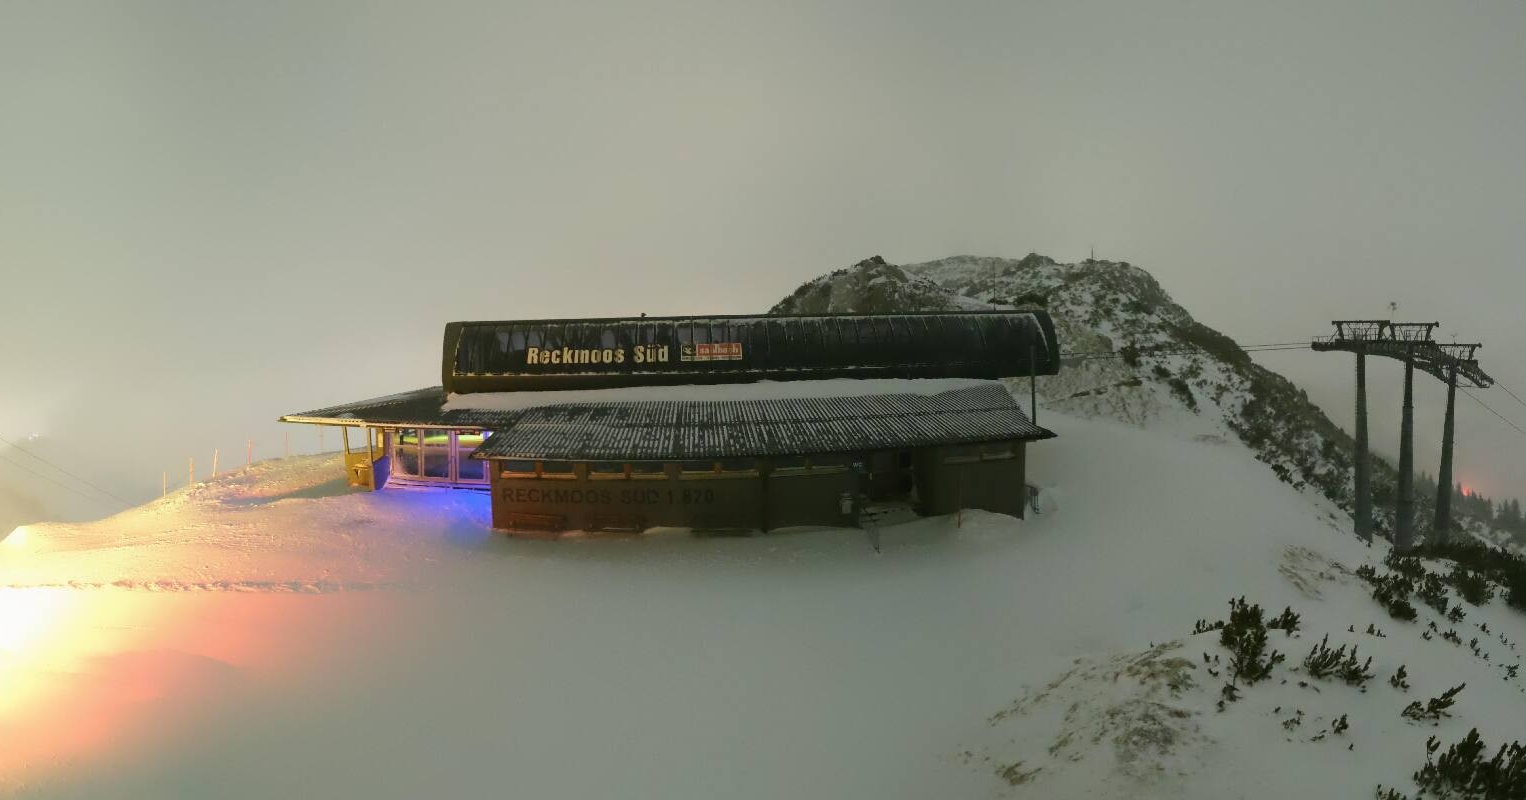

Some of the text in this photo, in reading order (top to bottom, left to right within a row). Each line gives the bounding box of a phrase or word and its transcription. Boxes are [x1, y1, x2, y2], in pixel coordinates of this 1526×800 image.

[527, 343, 669, 364] Reckmoos Süd
[502, 488, 611, 504] RECKMOOS
